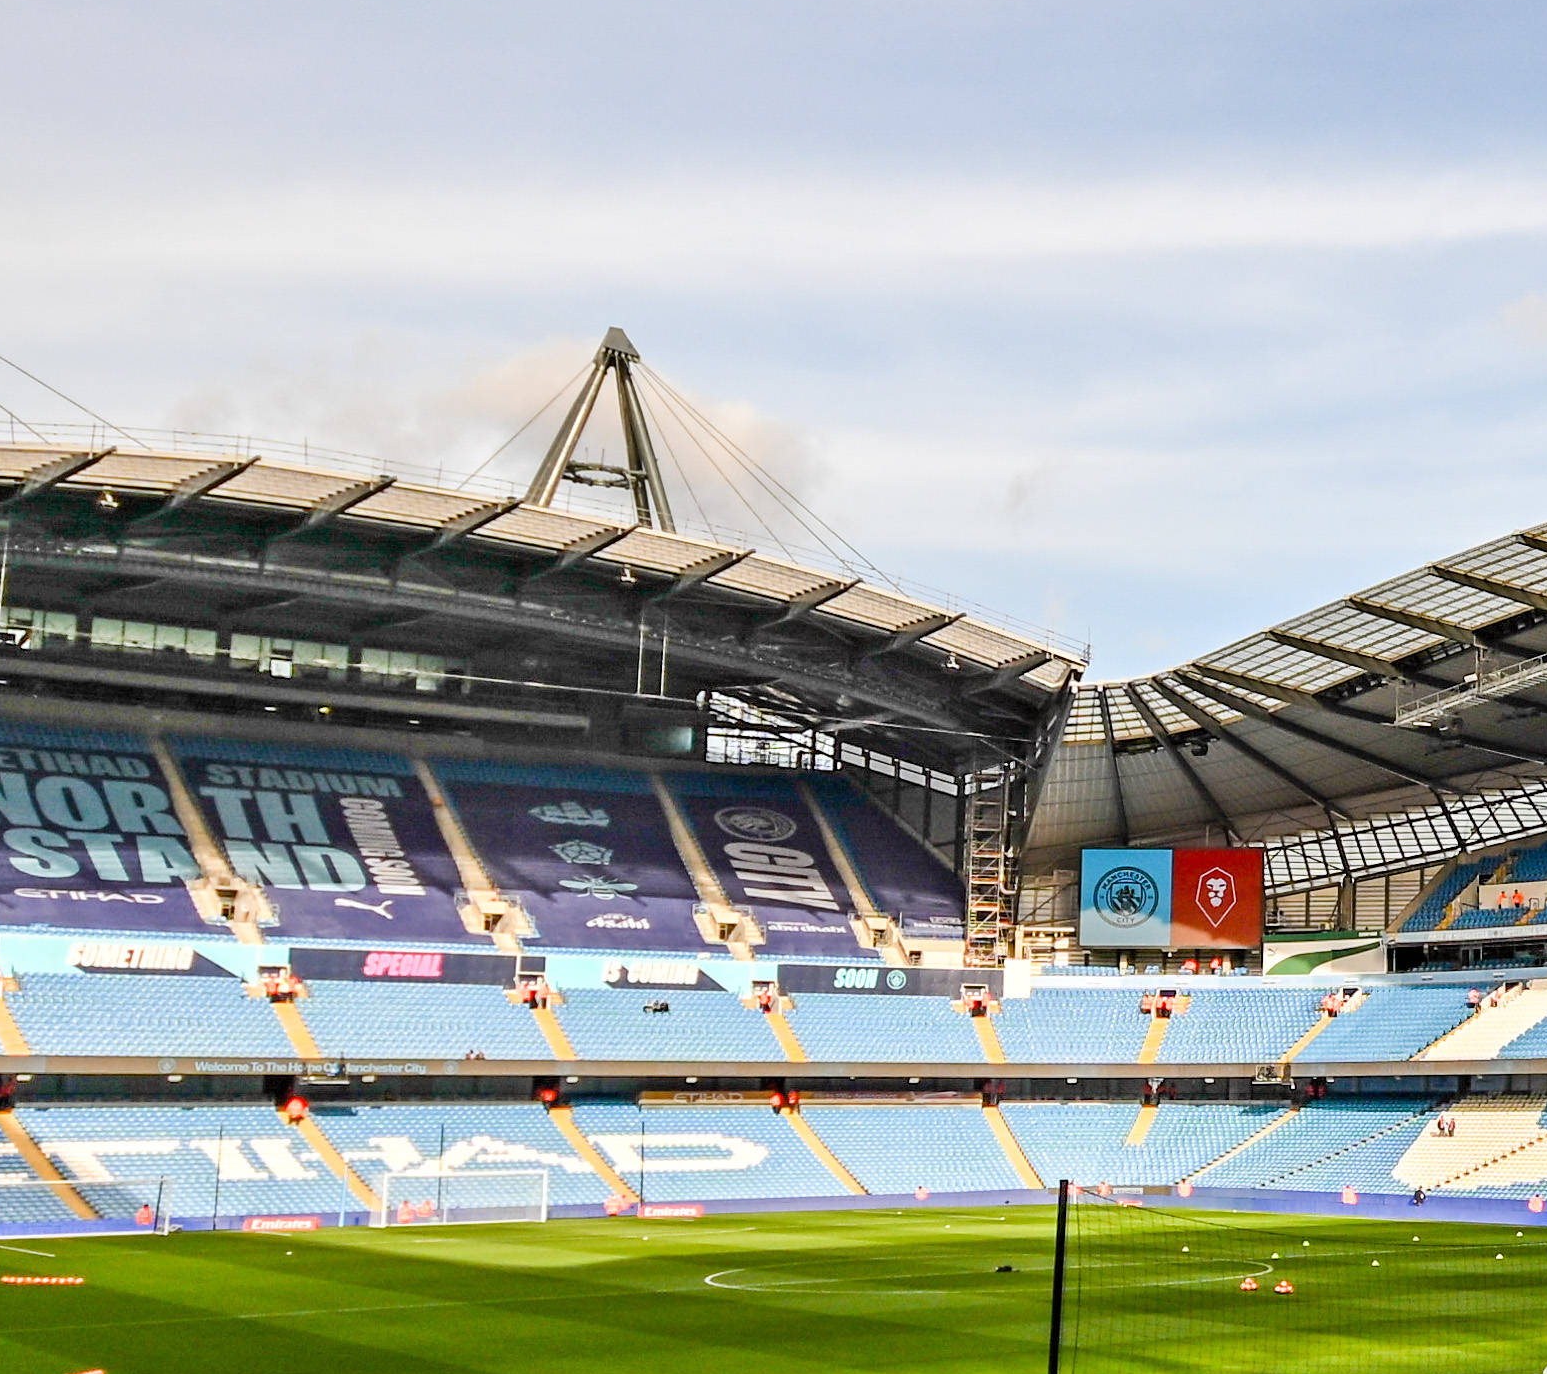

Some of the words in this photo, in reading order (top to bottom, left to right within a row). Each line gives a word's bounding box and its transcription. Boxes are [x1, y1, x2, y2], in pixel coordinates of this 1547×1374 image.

[206, 763, 405, 797] STADIUM
[3, 827, 367, 893] STAND
[364, 858, 427, 896] SOON
[723, 842, 840, 911] CITY
[1102, 871, 1151, 890] MANCHESTER
[14, 887, 165, 904] ETIHAD
[66, 943, 195, 971] SOMETHING
[363, 952, 444, 978] SPECIAL
[602, 961, 622, 983] IS
[626, 961, 700, 985] COMING
[834, 968, 879, 989] SOON
[195, 1061, 249, 1074] Welcome
[251, 1061, 265, 1073] To
[266, 1061, 287, 1073] The
[405, 1063, 428, 1075] City
[644, 1206, 697, 1217] Emirates
[251, 1218, 313, 1231] Emirates
